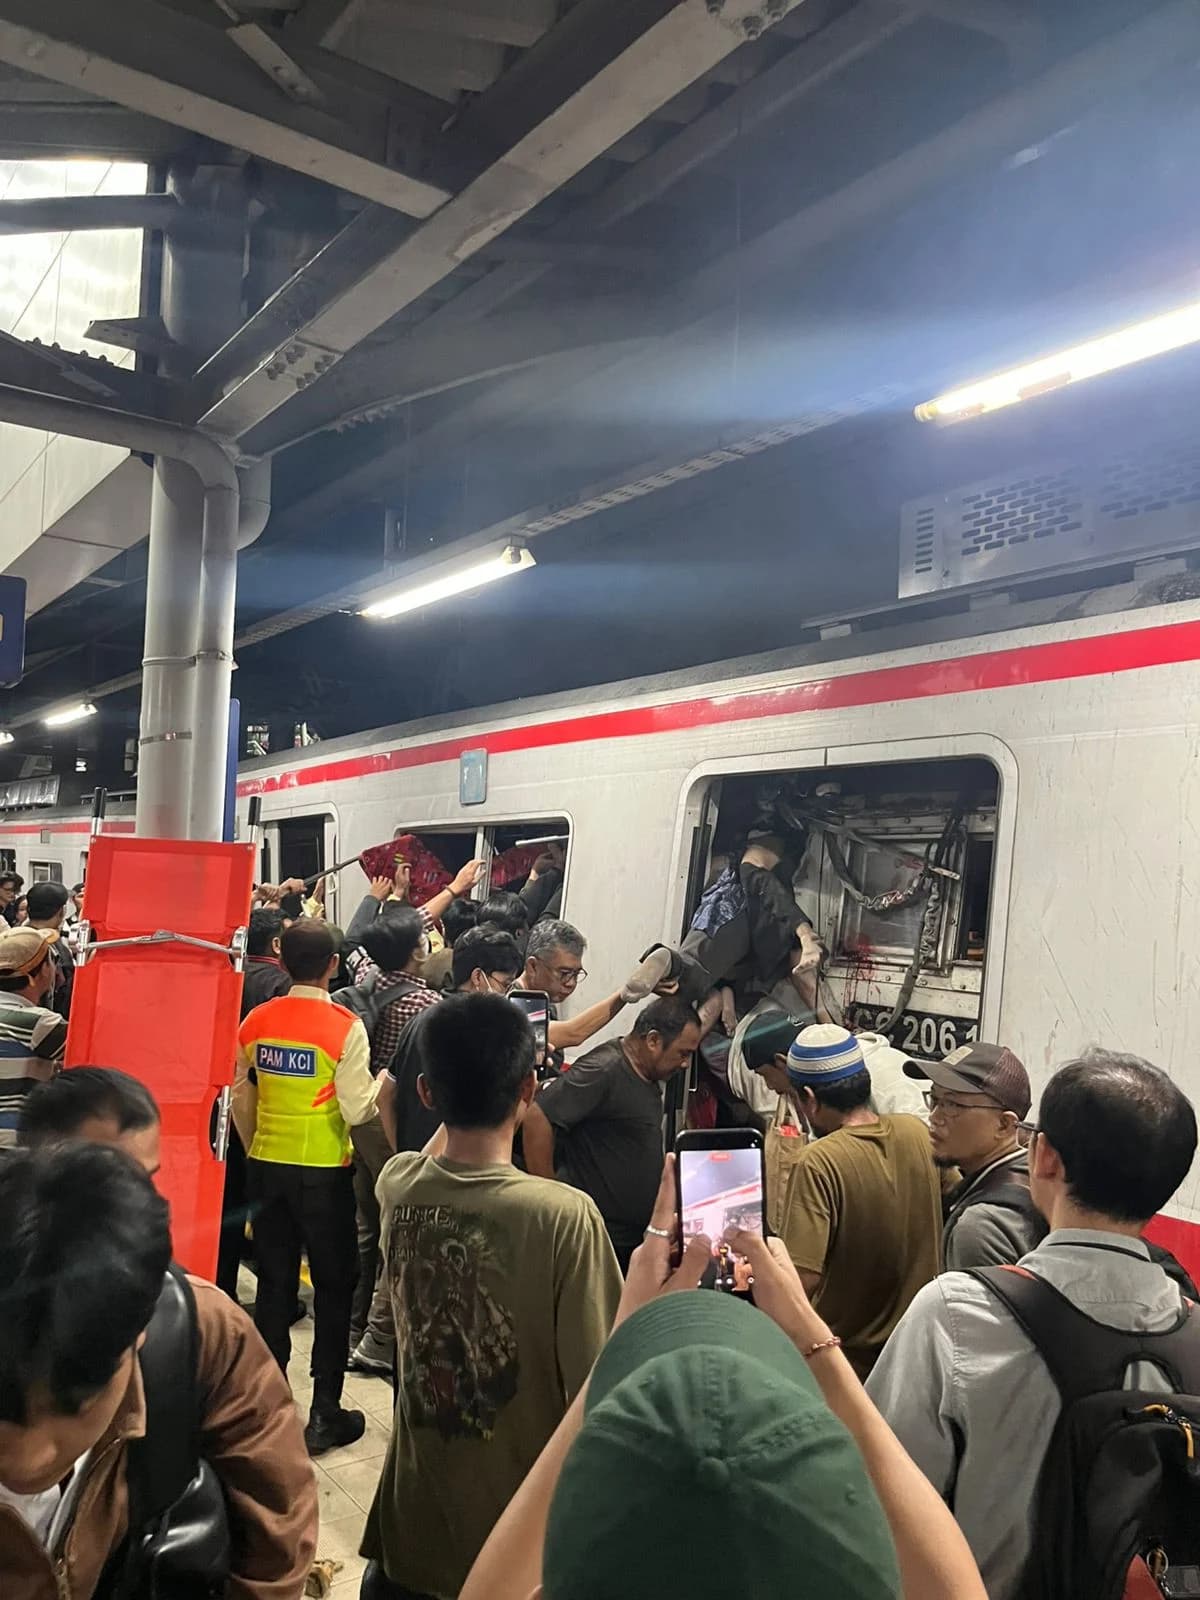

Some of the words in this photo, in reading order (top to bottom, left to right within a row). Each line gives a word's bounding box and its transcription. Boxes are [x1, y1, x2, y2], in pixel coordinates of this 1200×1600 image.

[902, 1015, 957, 1056] 206
[260, 1047, 283, 1068] PAM
[288, 1052, 311, 1071] KCI
